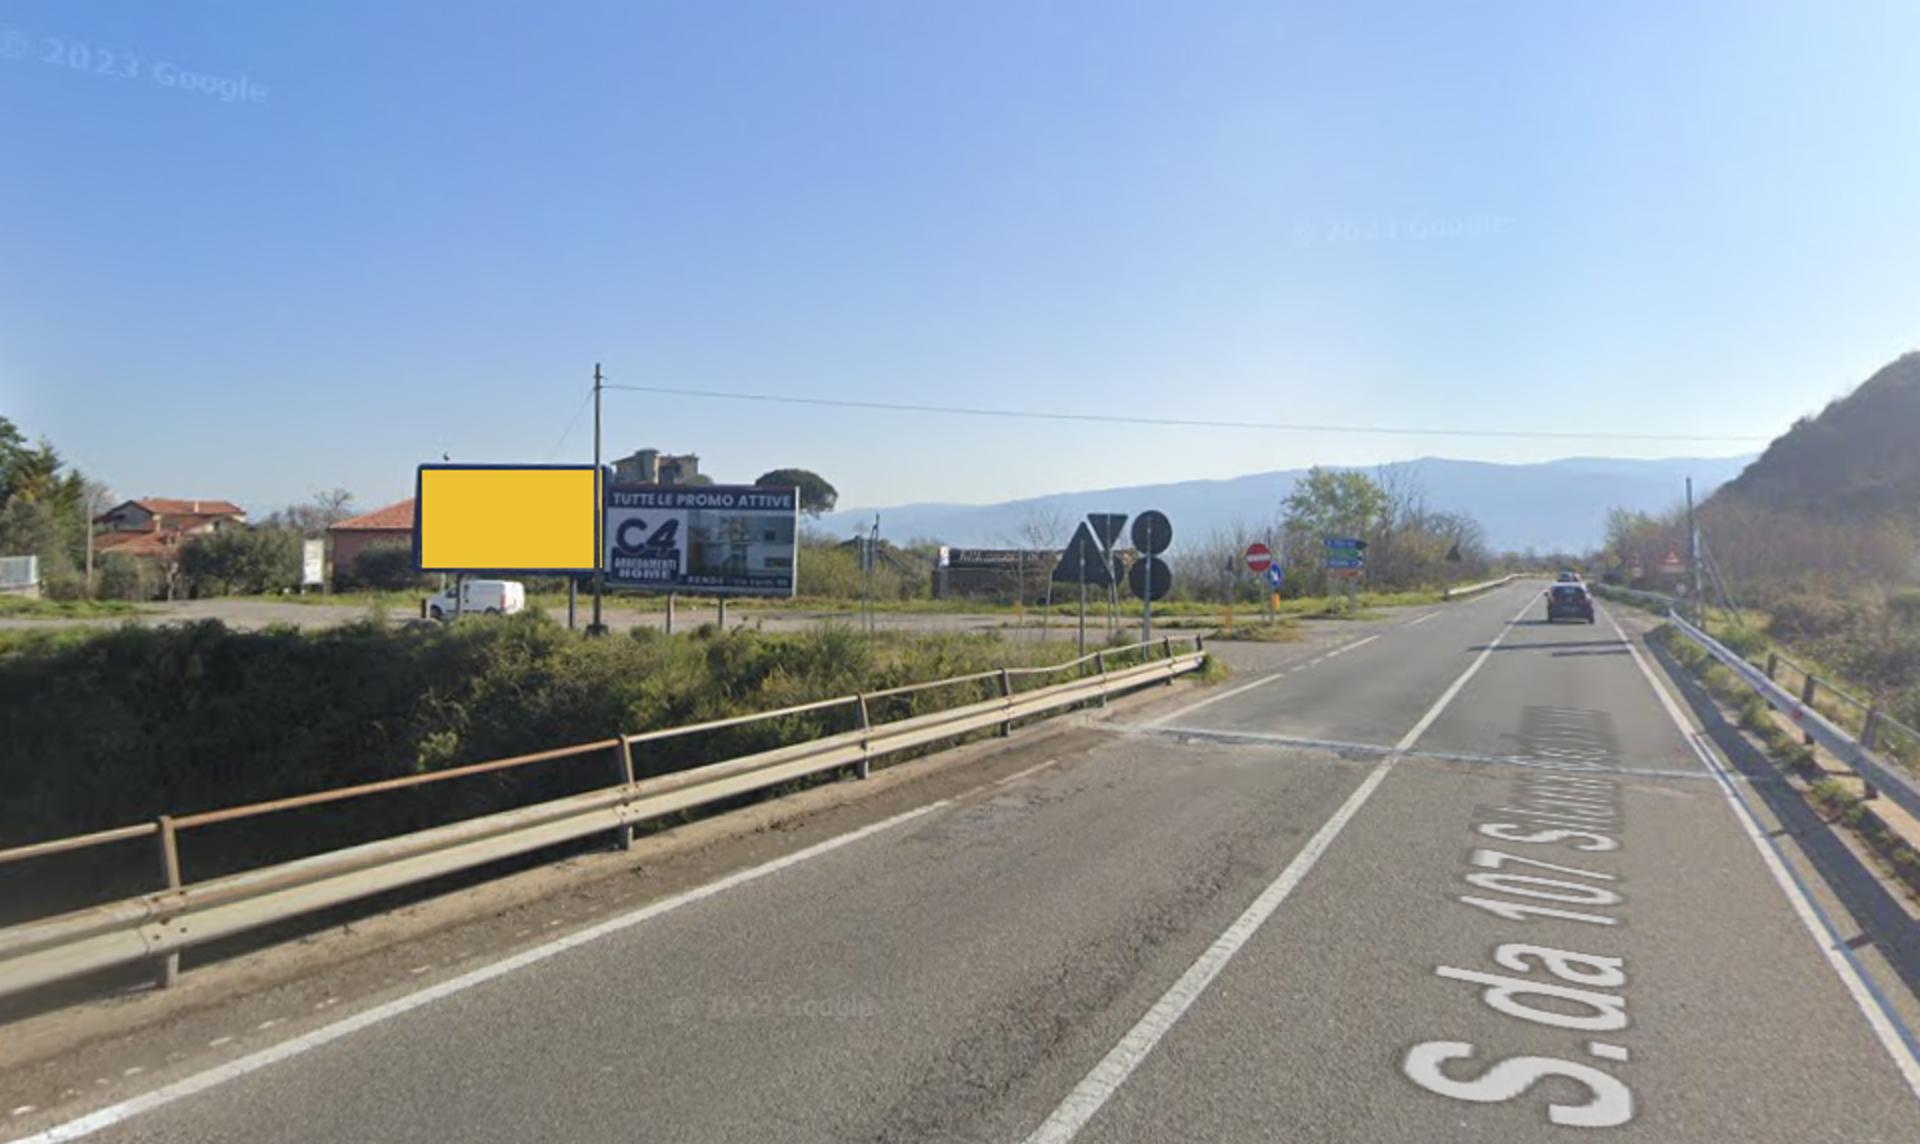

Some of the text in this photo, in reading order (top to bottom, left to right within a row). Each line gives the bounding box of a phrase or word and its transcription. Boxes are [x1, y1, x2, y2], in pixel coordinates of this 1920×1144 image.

[612, 492, 792, 508] TUTTE LE PROMO ATTIVE
[616, 517, 680, 554] C4
